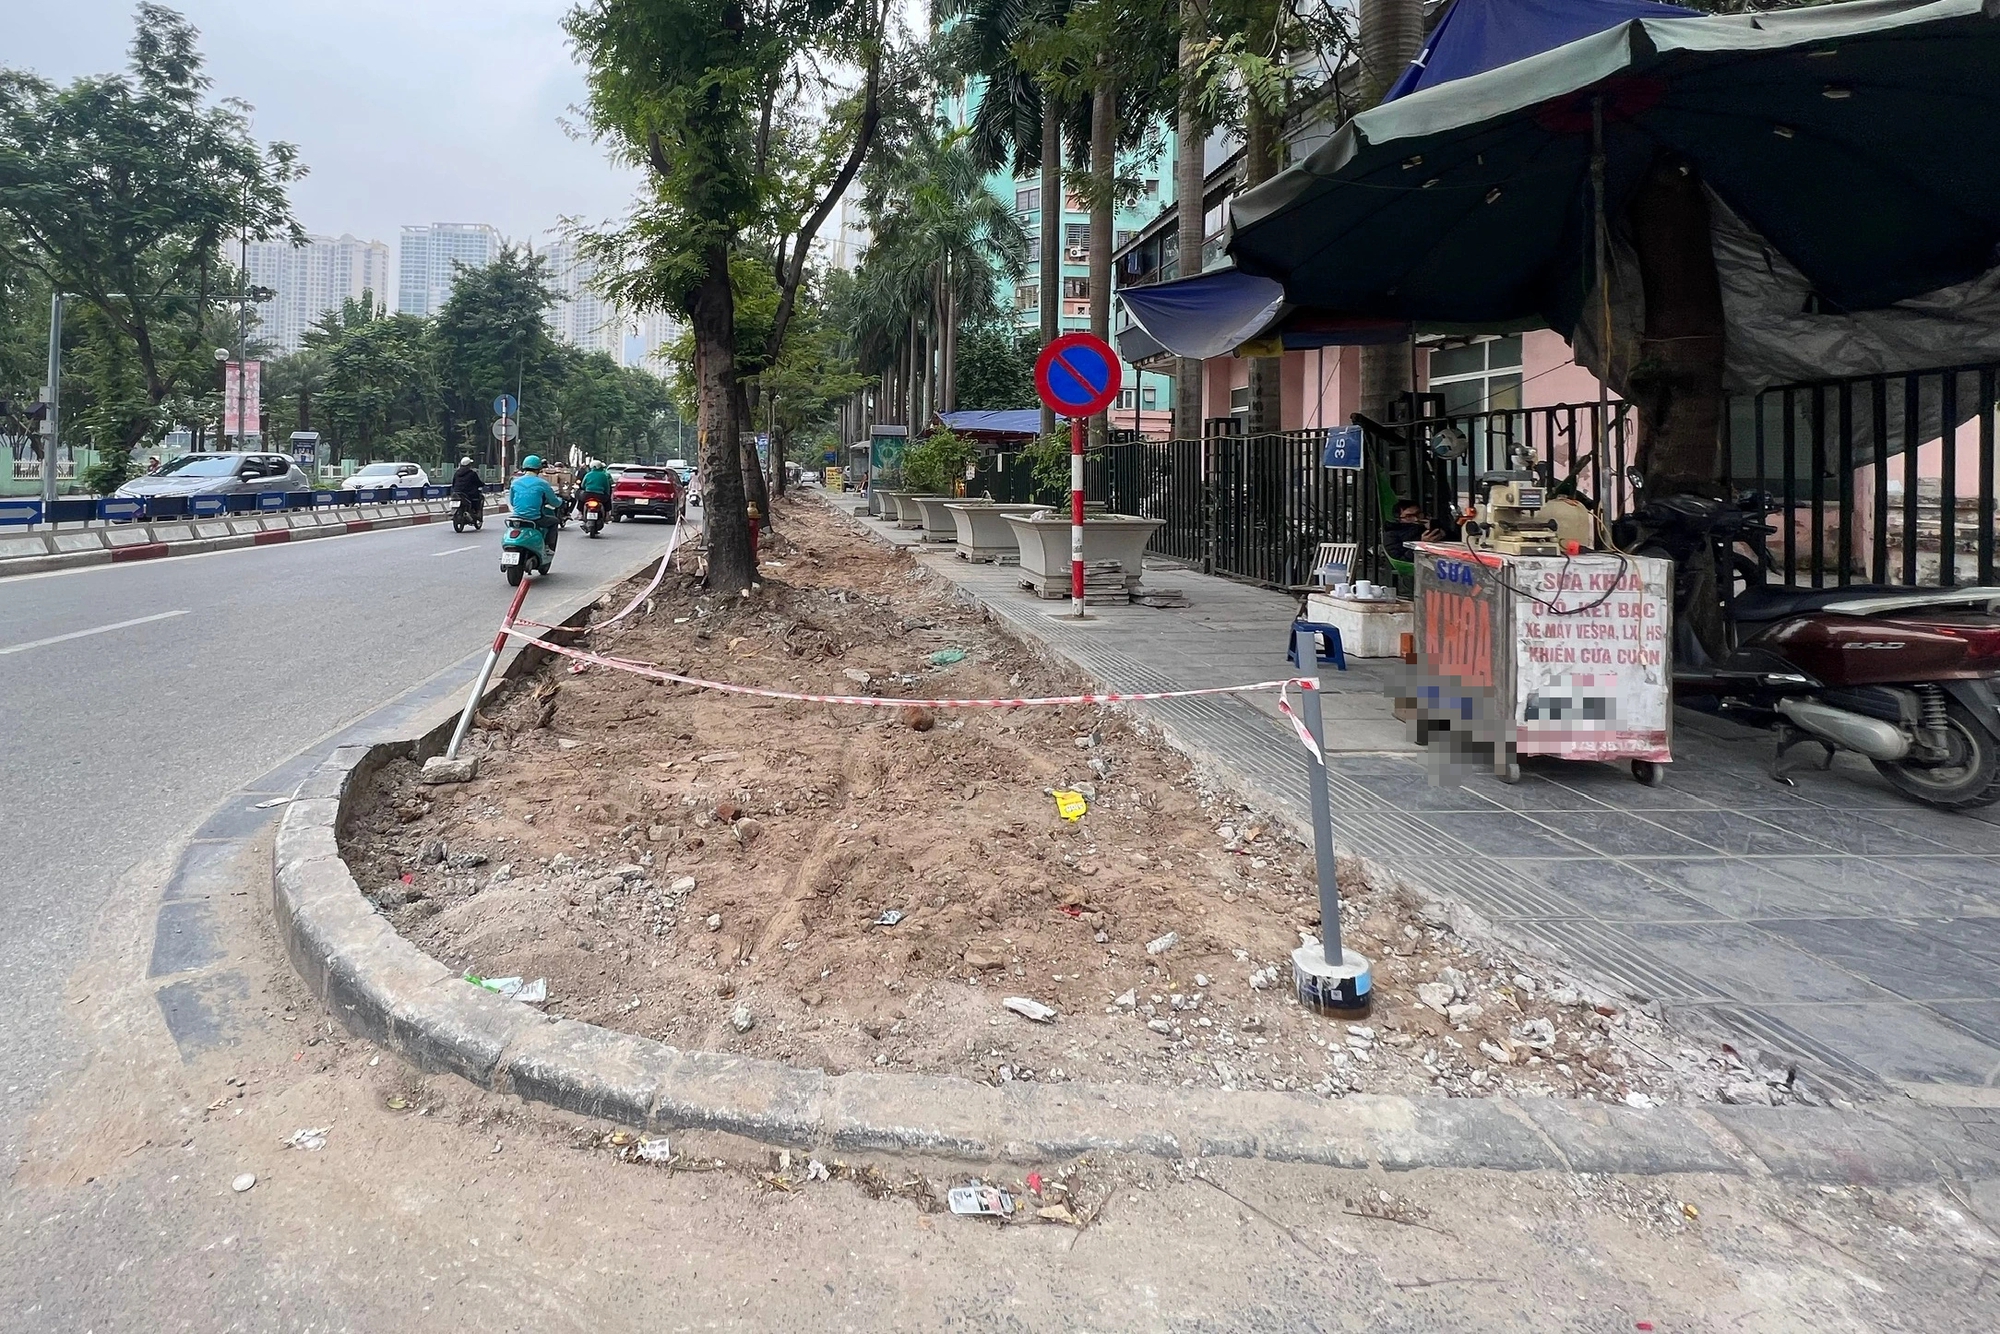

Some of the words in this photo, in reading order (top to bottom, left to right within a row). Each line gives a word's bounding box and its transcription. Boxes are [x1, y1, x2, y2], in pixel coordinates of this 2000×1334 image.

[1334, 438, 1346, 459] 35
[1426, 584, 1492, 686] KHÓA
[1526, 622, 1542, 639] XE
